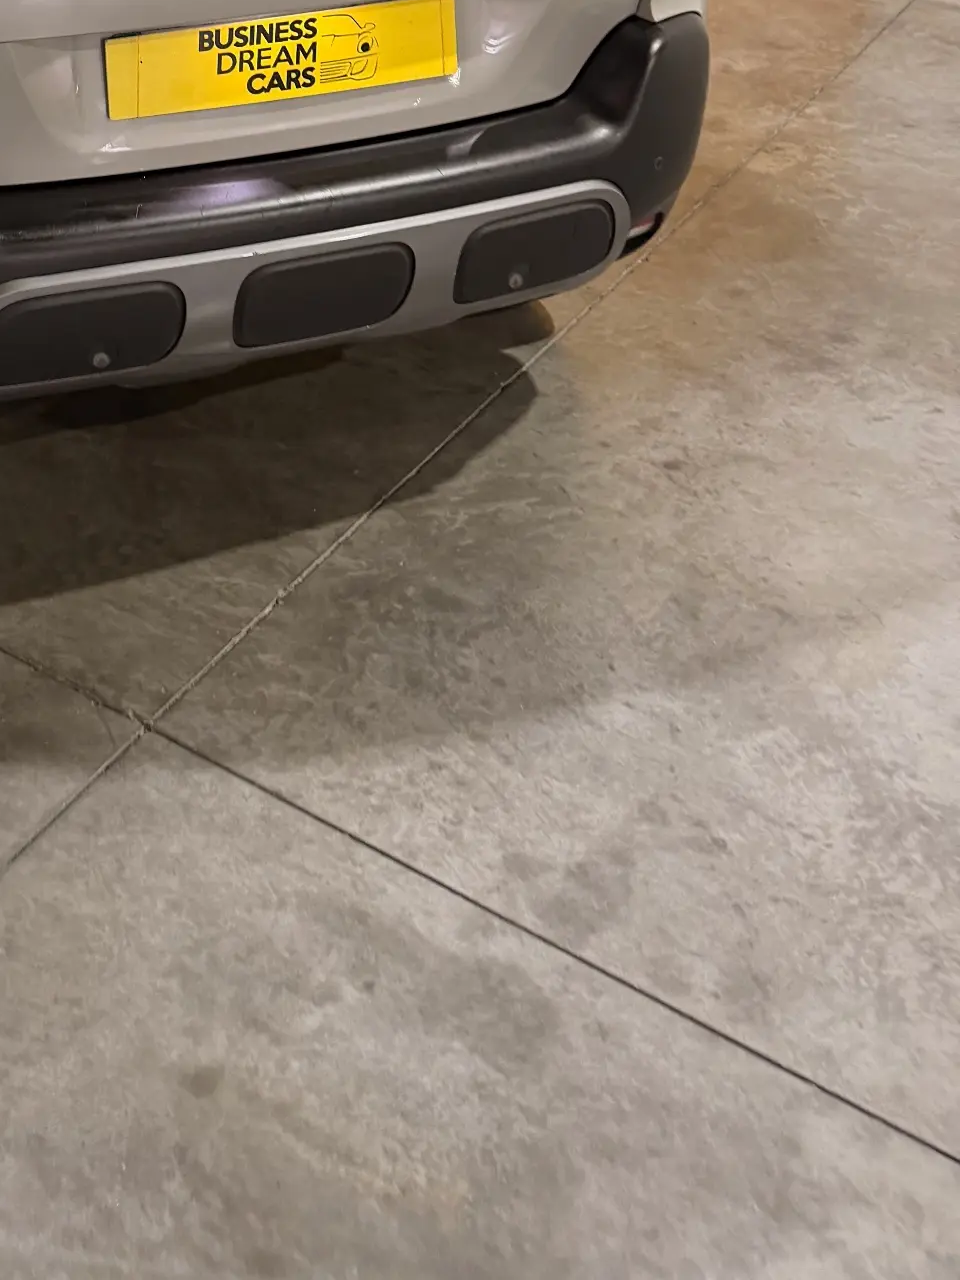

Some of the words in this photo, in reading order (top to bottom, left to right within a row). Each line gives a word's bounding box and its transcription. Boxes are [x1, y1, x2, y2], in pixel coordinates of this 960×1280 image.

[198, 17, 318, 52] BUSINESS
[216, 41, 317, 75] DREAM
[246, 66, 316, 95] CARS
